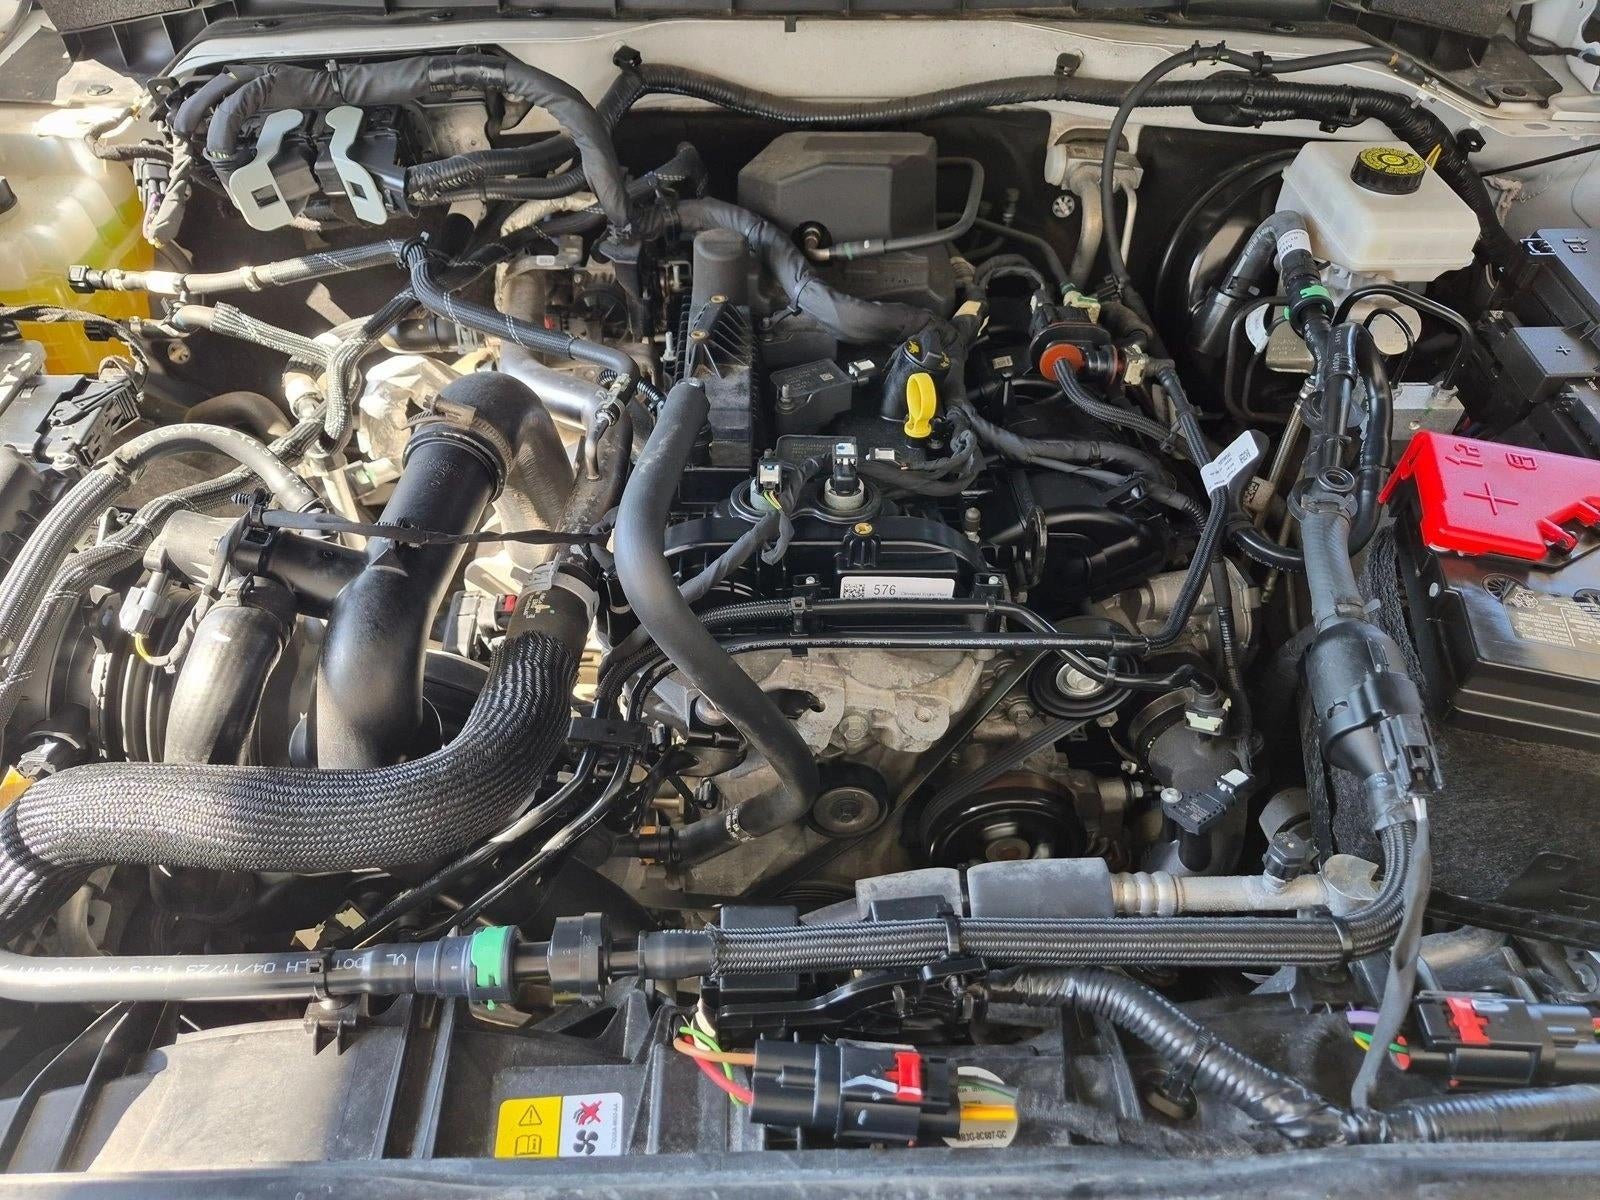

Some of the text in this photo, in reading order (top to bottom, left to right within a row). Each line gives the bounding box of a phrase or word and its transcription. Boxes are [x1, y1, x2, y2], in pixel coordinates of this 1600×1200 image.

[873, 584, 897, 596] 576
[753, 640, 784, 649] STANDARD
[186, 962, 276, 975] 04/17/23
[335, 957, 366, 971] DOT
